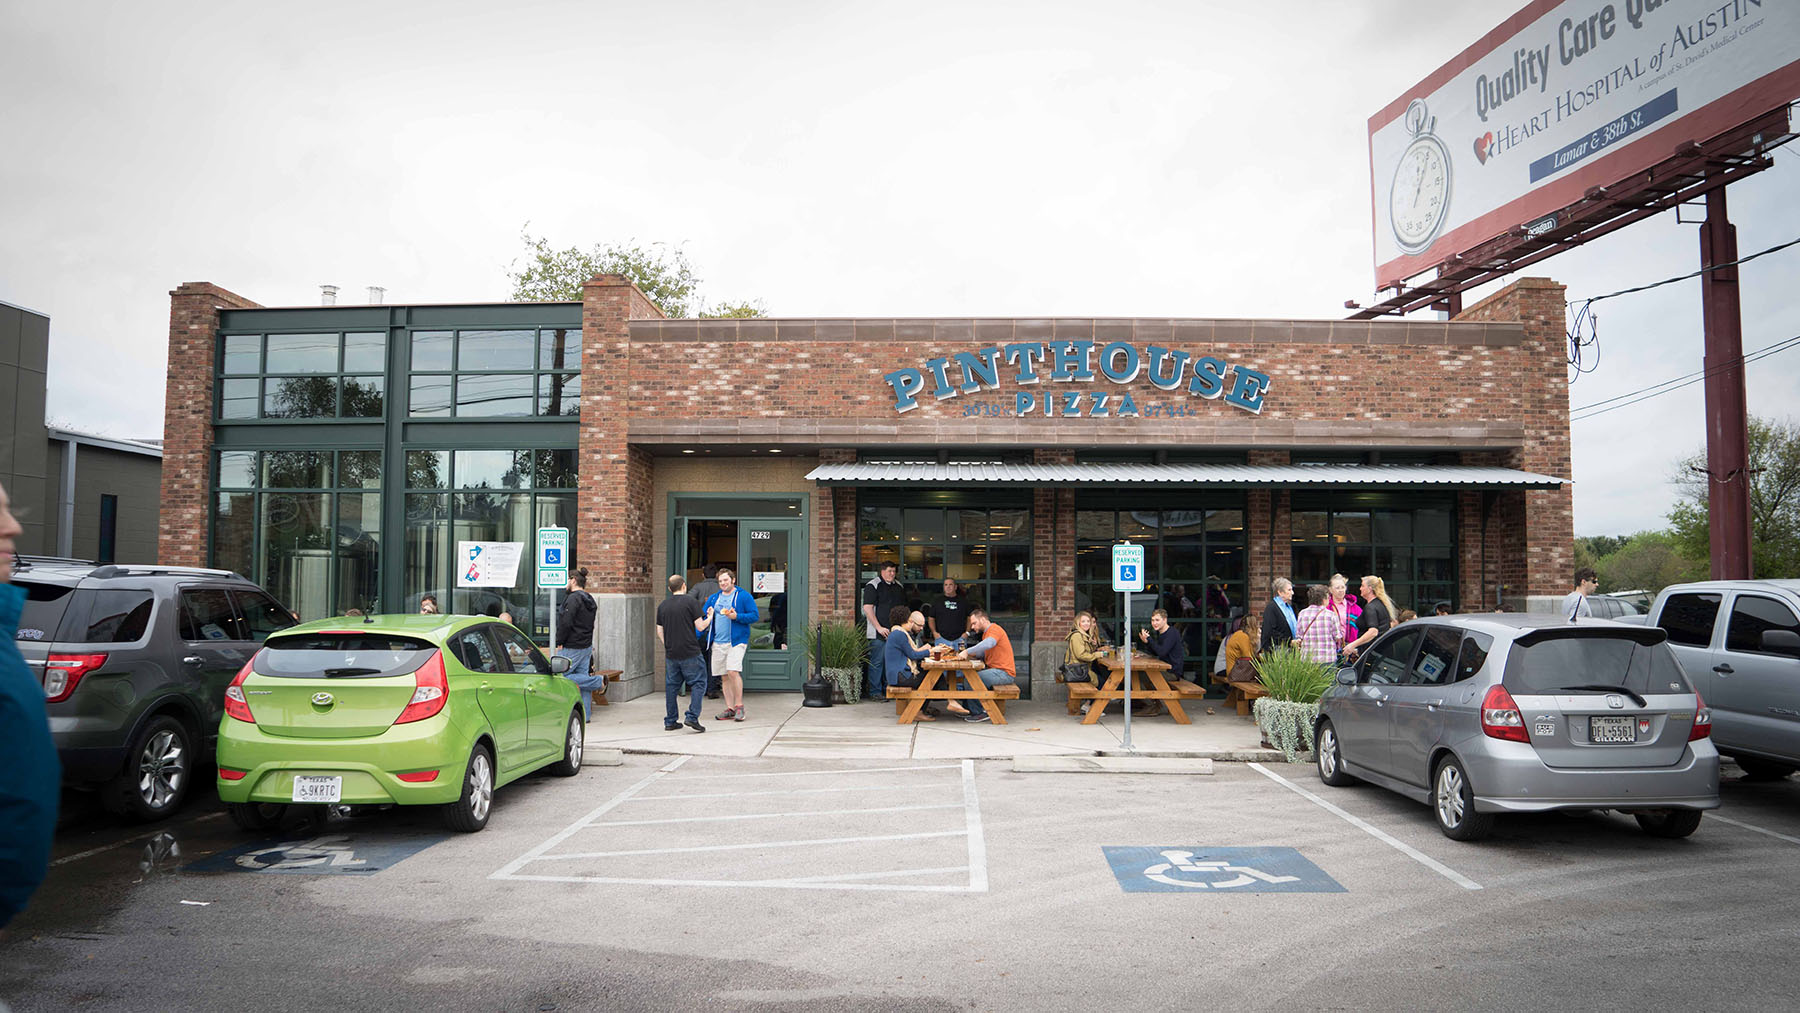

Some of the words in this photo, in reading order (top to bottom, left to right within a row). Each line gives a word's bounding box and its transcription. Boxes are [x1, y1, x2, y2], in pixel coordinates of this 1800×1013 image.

[1475, 43, 1550, 122] Quality
[1558, 4, 1616, 66] Care
[1710, 31, 1738, 53] Medical
[1739, 17, 1765, 37] Center
[1496, 108, 1552, 155] HEART
[1555, 57, 1646, 122] HOSPITAL
[1650, 43, 1667, 72] of
[1553, 141, 1589, 169] Lamar
[1590, 132, 1600, 150] &
[1601, 117, 1628, 146] 38th
[1630, 110, 1644, 129] St.
[883, 340, 1271, 415] PINTHOUSE
[1016, 391, 1140, 418] PIZZA
